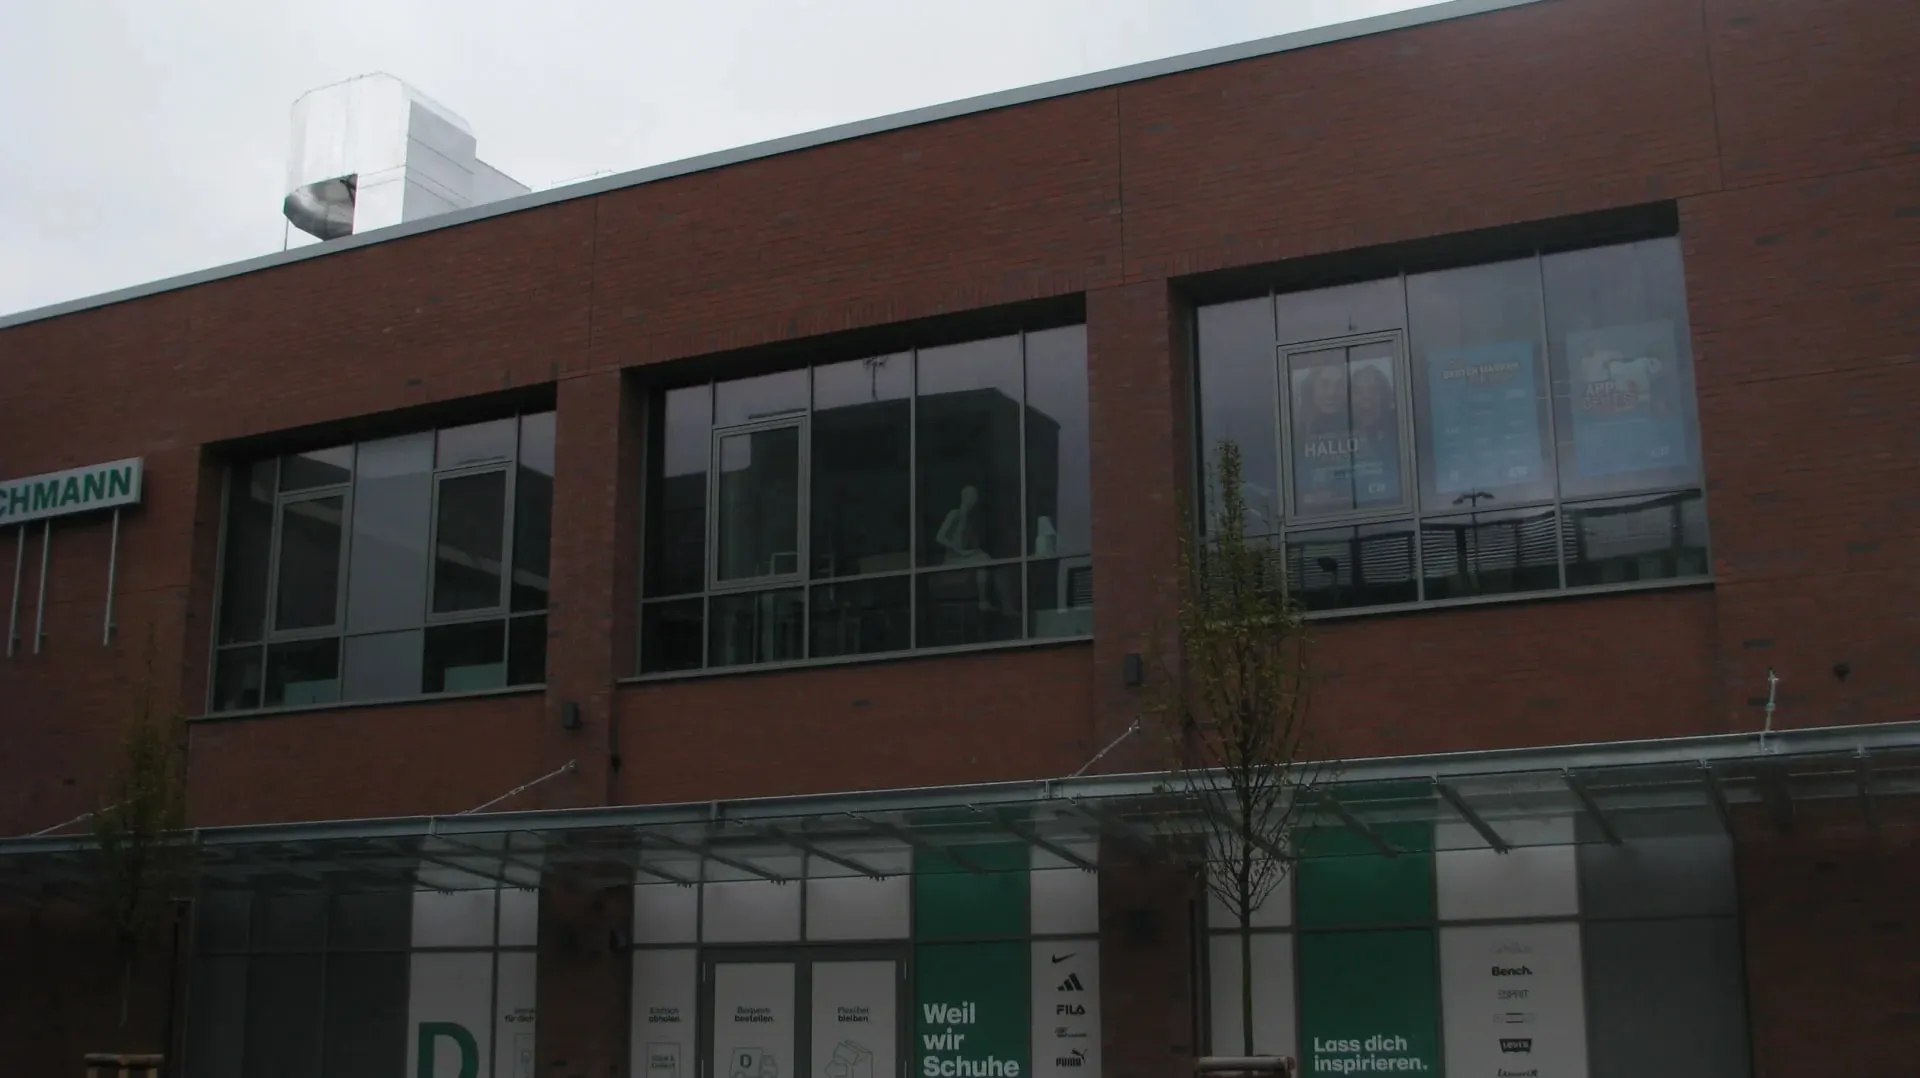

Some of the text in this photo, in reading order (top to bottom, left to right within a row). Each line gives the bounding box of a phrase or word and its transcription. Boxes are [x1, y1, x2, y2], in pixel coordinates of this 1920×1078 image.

[1304, 437, 1360, 458] HALLO
[922, 1000, 976, 1024] Weil
[1055, 1004, 1086, 1016] FILA
[417, 1021, 479, 1078] D
[922, 1027, 965, 1051] wir
[1313, 1034, 1408, 1053] Lass dich
[739, 1053, 753, 1068] D
[922, 1055, 1020, 1078] Schuhe
[1313, 1054, 1429, 1075] inspirieren.
